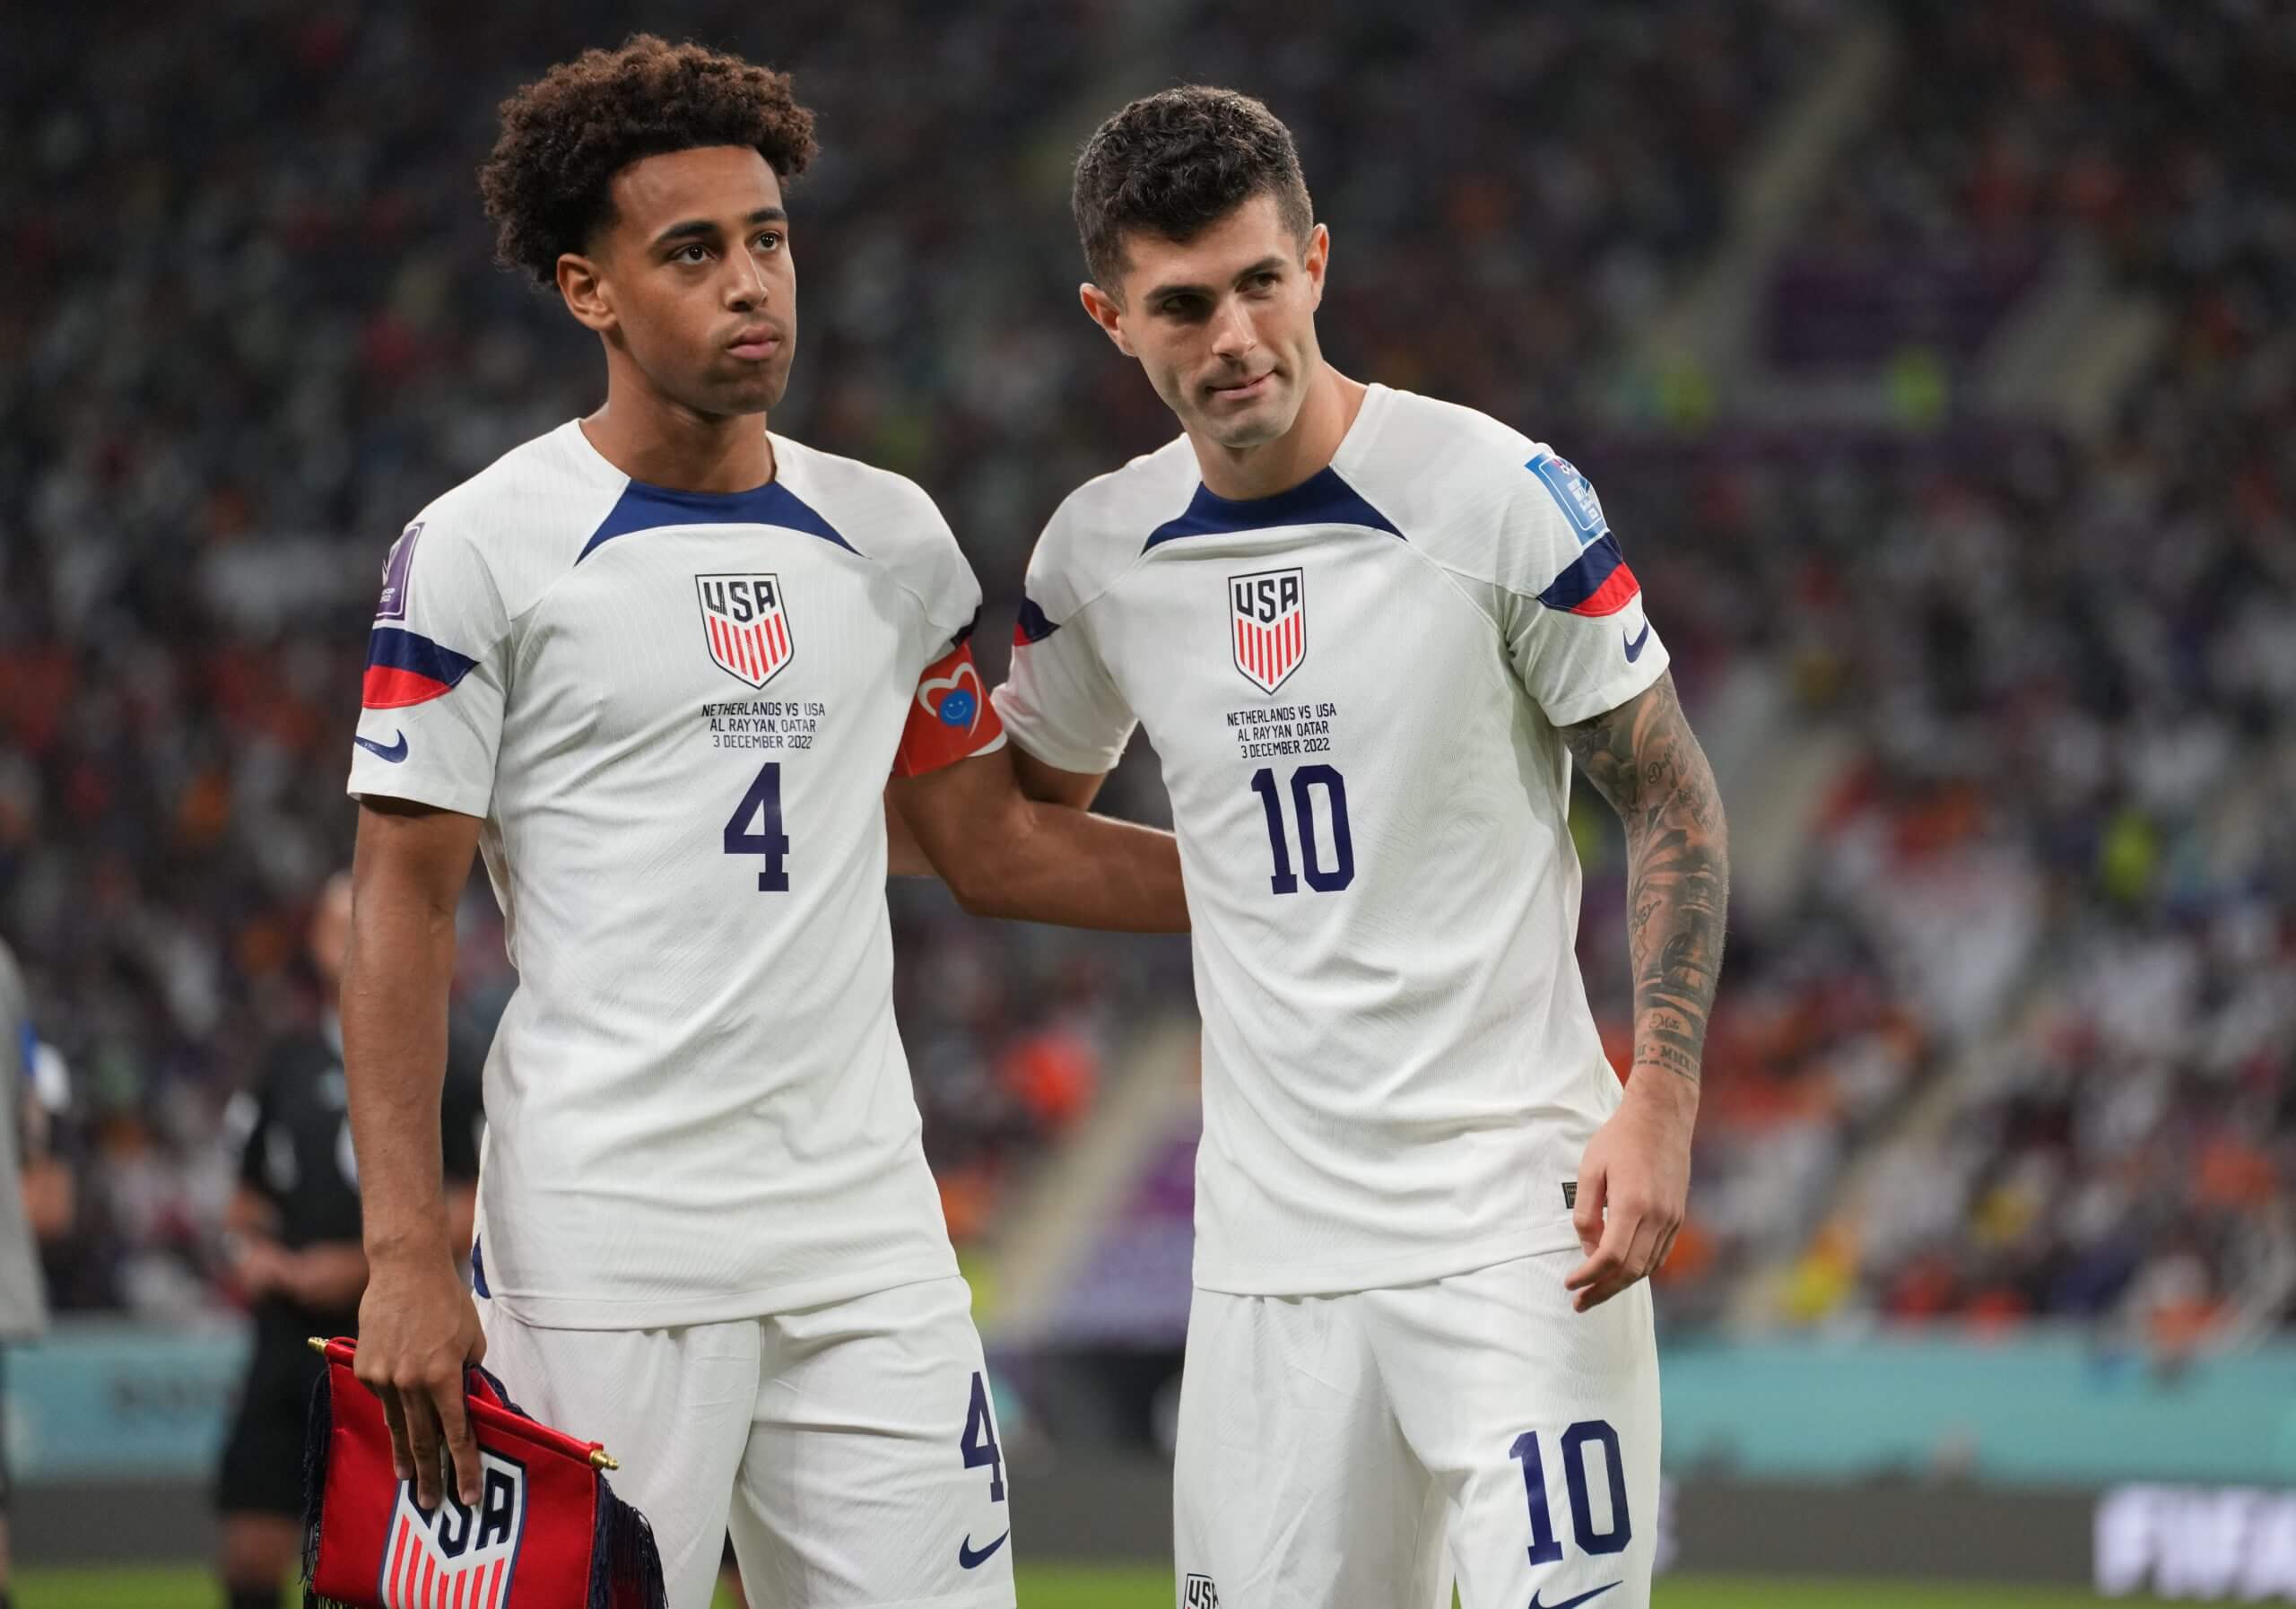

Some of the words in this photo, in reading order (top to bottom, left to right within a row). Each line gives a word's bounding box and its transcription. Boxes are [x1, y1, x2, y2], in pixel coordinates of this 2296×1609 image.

[703, 581, 777, 623] USA
[1235, 576, 1299, 623] USA
[701, 702, 782, 717] NETHERLANDS
[785, 702, 799, 717] VS
[804, 702, 826, 717] USA
[709, 718, 725, 732] AL
[781, 719, 816, 733] QATAR
[1227, 707, 1296, 726] NETHERLANDS
[1298, 705, 1311, 719] VS
[1316, 703, 1337, 718] USA
[712, 735, 720, 748] 3
[723, 735, 784, 749] DECEMBER
[787, 735, 813, 750] 2022
[1238, 727, 1250, 743] AL
[1296, 720, 1330, 737] QATAR
[1240, 744, 1248, 759] 3
[1249, 740, 1301, 758] DECEMBER
[1303, 737, 1331, 752] 2022
[724, 762, 790, 891] 4
[1250, 764, 1355, 895] 10
[961, 1370, 1005, 1503] 4
[1509, 1420, 1632, 1566] 10
